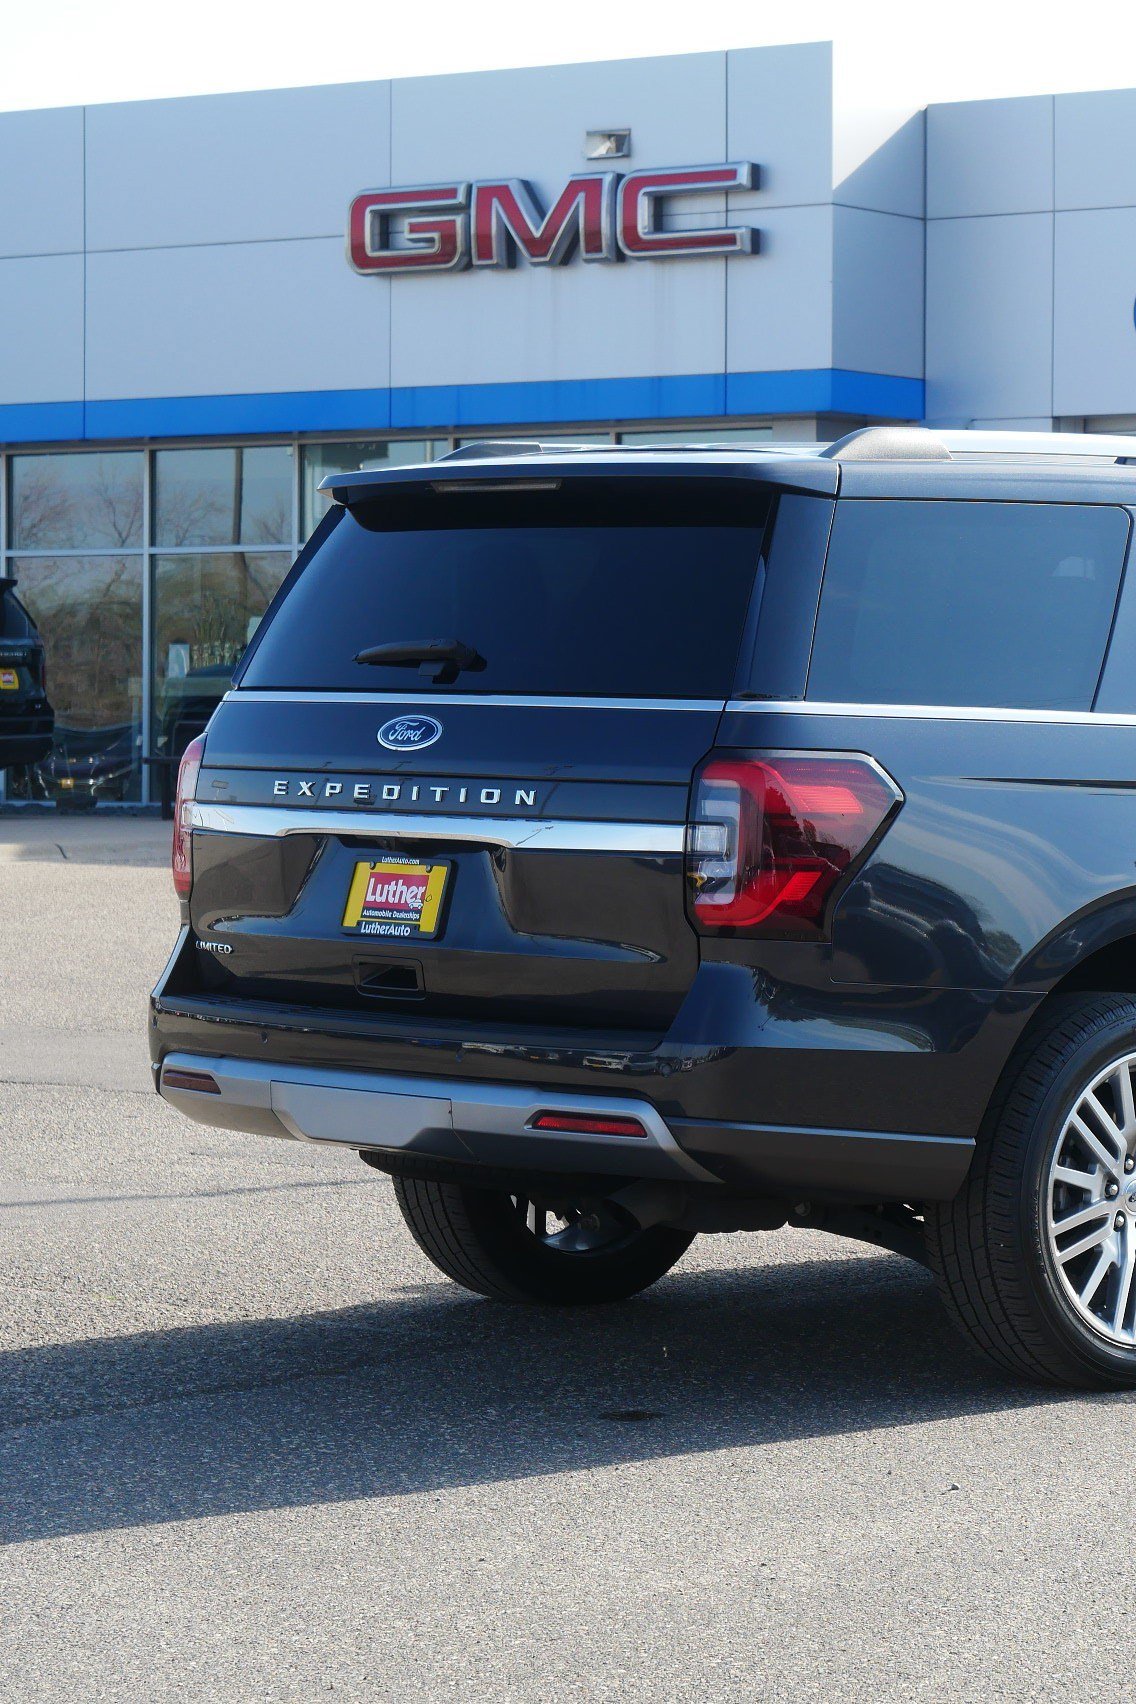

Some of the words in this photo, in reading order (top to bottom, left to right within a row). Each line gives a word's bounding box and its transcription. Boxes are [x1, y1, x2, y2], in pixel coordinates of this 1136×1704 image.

[345, 161, 760, 276] GMC
[388, 721, 426, 741] Ford
[273, 779, 538, 806] EXPEDITION
[381, 856, 420, 865] LutherAuto.com
[366, 878, 426, 904] Luther
[362, 909, 392, 918] Automobile
[393, 910, 420, 920] Dealerships
[361, 922, 411, 936] LutherAuto
[195, 940, 233, 954] LIMITED
